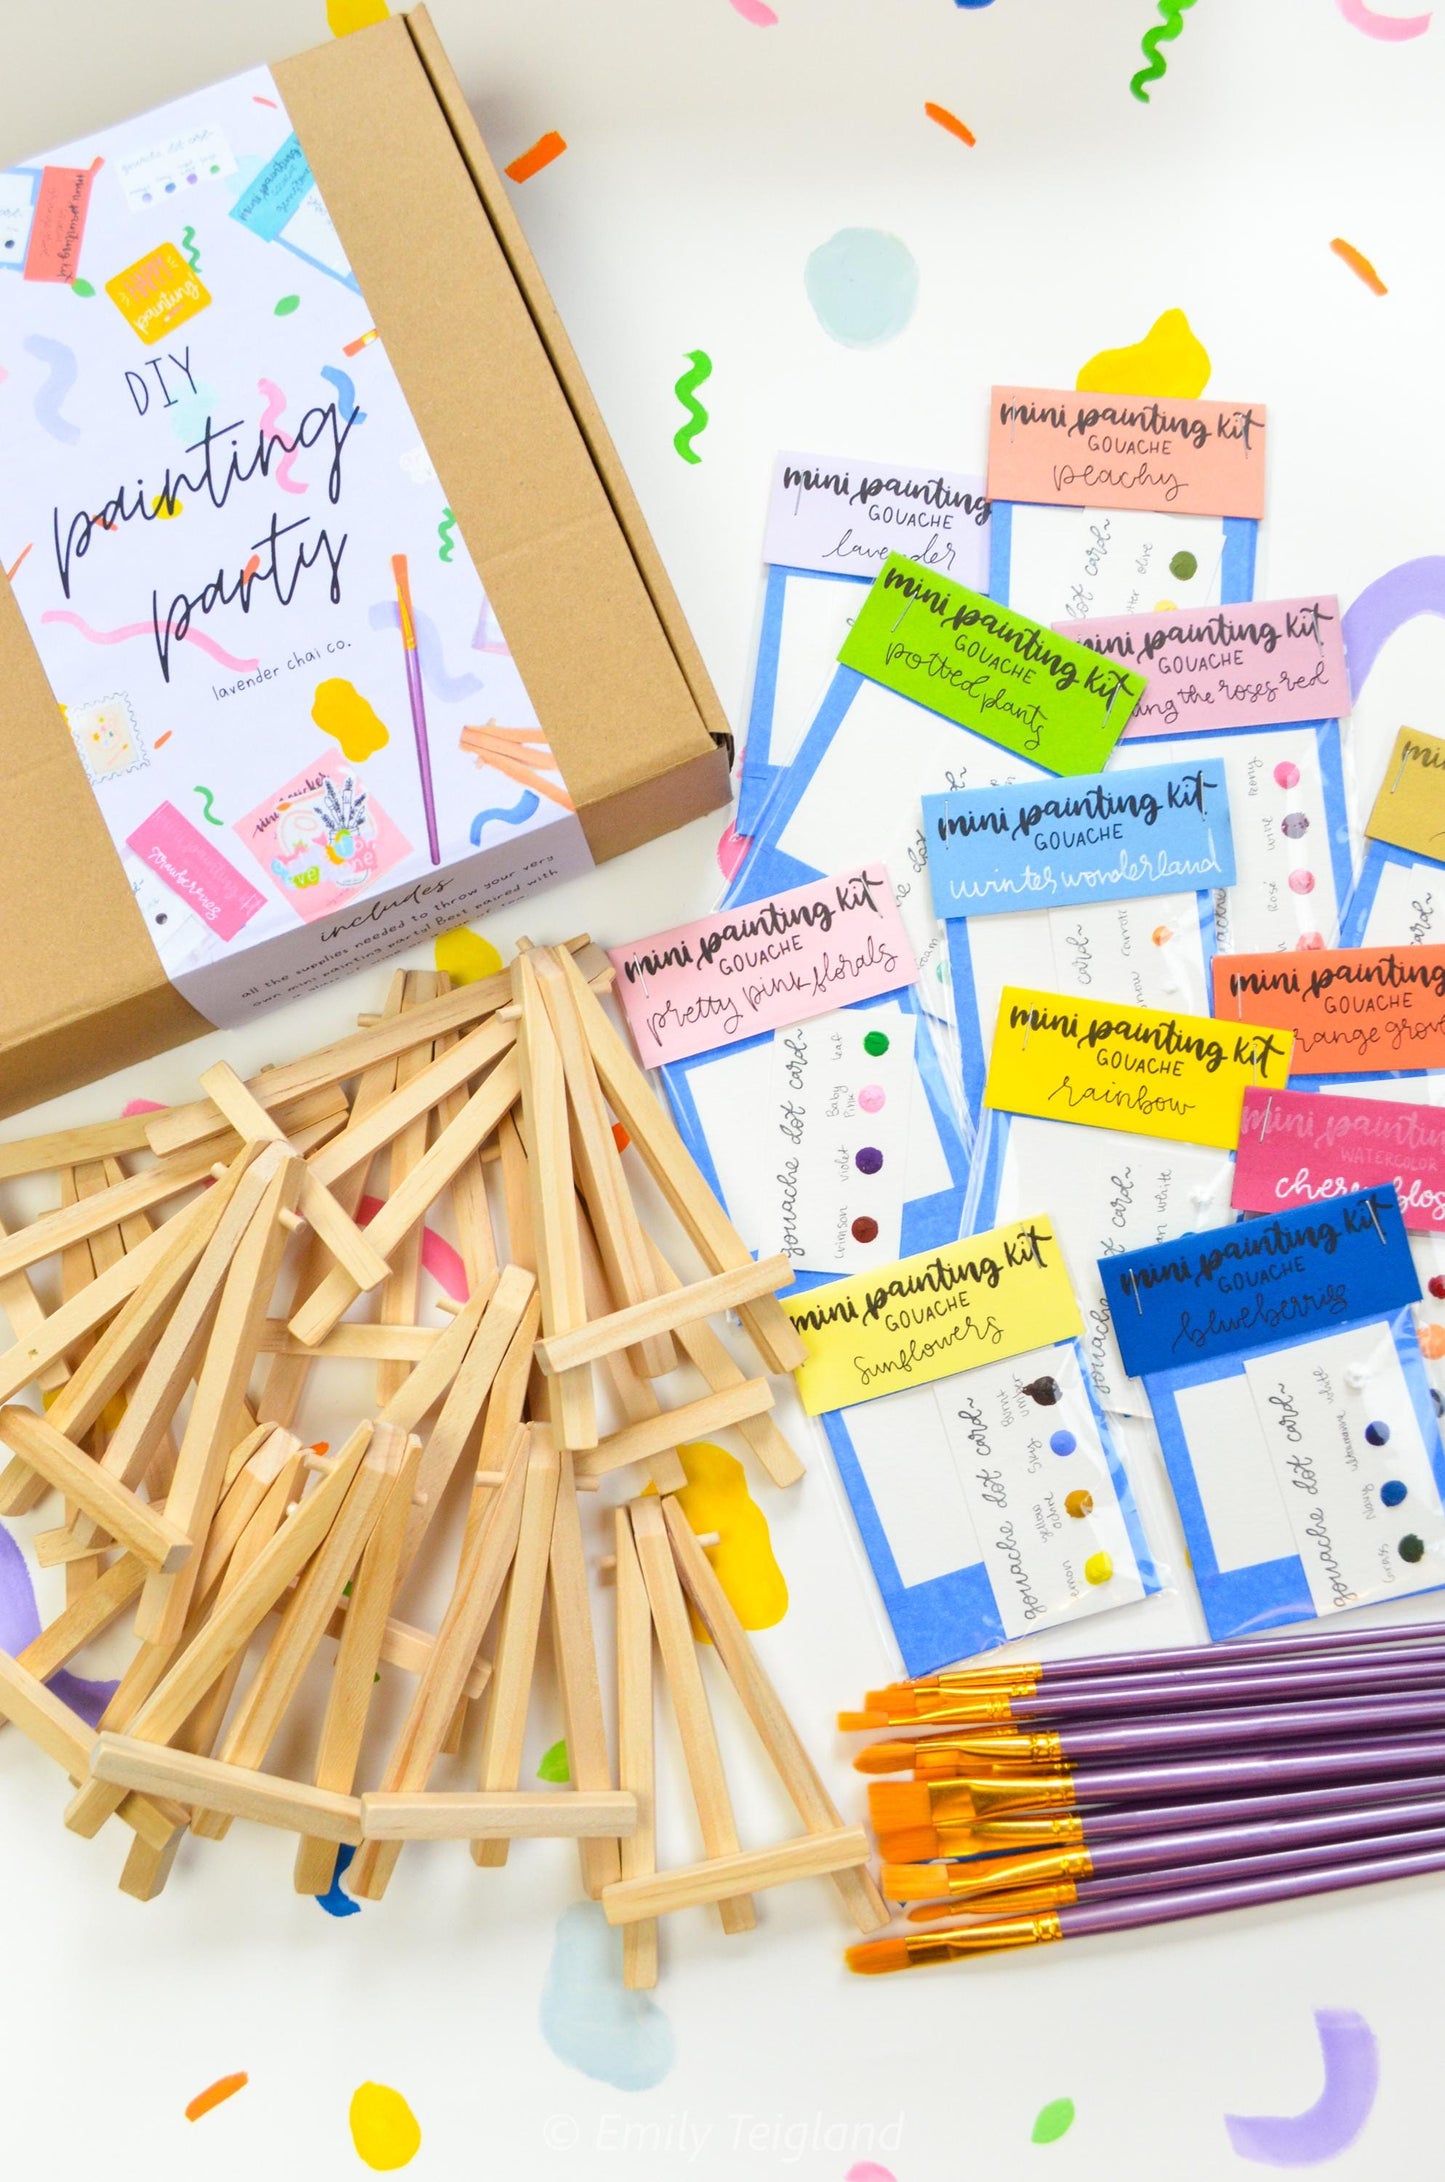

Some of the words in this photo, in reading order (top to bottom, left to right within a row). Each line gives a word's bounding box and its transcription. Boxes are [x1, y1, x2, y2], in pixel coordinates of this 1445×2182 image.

[124, 346, 197, 415] DIY
[1000, 400, 1067, 430] mini
[1067, 403, 1213, 449] painting
[1217, 408, 1265, 450] kit
[1088, 434, 1172, 455] GOUACHE
[54, 402, 360, 600] painting
[783, 465, 851, 496] mini
[849, 476, 992, 526] painting
[1053, 462, 1190, 501] peachy
[868, 504, 954, 530] GOUACHE
[821, 528, 956, 571] laveder
[152, 512, 348, 683] party
[883, 567, 950, 617] mini
[940, 603, 1080, 691] painting
[1083, 665, 1135, 714] kit
[1136, 613, 1283, 665] painting
[1286, 601, 1335, 647] kit
[212, 665, 279, 701] lavender
[286, 647, 322, 671] chai
[326, 640, 352, 655] co.
[953, 633, 1038, 686] GOUACHE
[1158, 650, 1244, 675] GOUACHE
[1177, 684, 1215, 706] the
[1219, 678, 1279, 704] roses
[1279, 660, 1330, 691] red
[885, 641, 990, 699] potted
[980, 688, 1048, 751] plants
[1402, 740, 1445, 771] mi
[938, 806, 1009, 842] mini
[1012, 784, 1164, 842] painting
[1166, 769, 1219, 818] kit
[1033, 823, 1125, 852] GOUACHE
[949, 864, 1058, 901] winter
[1061, 828, 1222, 889] wonderland
[241, 986, 259, 998] all
[264, 974, 289, 988] the
[295, 949, 349, 975] supplies
[354, 921, 405, 949] needed
[411, 912, 428, 923] to
[434, 889, 479, 911] throw
[483, 871, 516, 890] your
[523, 855, 555, 871] very
[320, 877, 454, 942] includes
[623, 939, 694, 985] mini
[696, 901, 837, 971] painting
[835, 869, 884, 917] kit
[252, 993, 282, 1007] own
[322, 946, 383, 977] painting
[436, 908, 469, 926] Best
[474, 884, 521, 909] paired
[527, 869, 559, 886] with
[718, 935, 803, 976] GOUACHE
[646, 996, 744, 1047] pretty
[742, 967, 812, 1012] pink
[811, 935, 899, 997] florals
[1230, 966, 1300, 998] mini
[1302, 953, 1445, 1003] painting
[1324, 992, 1414, 1015] GOUACHE
[1009, 1004, 1079, 1039] mini
[1077, 1019, 1229, 1074] painting
[1232, 1033, 1286, 1079] kit
[1096, 1047, 1185, 1078] GOUACHE
[1292, 1027, 1381, 1056] range
[826, 1084, 850, 1118] Baby
[1047, 1075, 1196, 1116] rainbow
[779, 1099, 806, 1145] dot
[1241, 1104, 1314, 1139] mini
[1312, 1109, 1445, 1156] paintin
[1339, 1146, 1438, 1172] WATERCOLOR
[776, 1155, 806, 1258] gouache
[1119, 1255, 1192, 1297] mini
[1194, 1220, 1342, 1288] painting
[1342, 1192, 1395, 1237] kit
[790, 1295, 860, 1333] mini
[862, 1256, 1005, 1327] painting
[1003, 1224, 1053, 1269] kit
[1217, 1255, 1307, 1295] GOUACHE
[886, 1290, 971, 1333] GOUACHE
[1171, 1282, 1349, 1354] blueberries
[974, 1468, 1009, 1510] dot
[1286, 1454, 1319, 1496] dot
[1361, 1483, 1378, 1521] Navy
[995, 1520, 1048, 1621] gouache
[1061, 1559, 1081, 1598] emon
[1304, 1506, 1359, 1609] gouache
